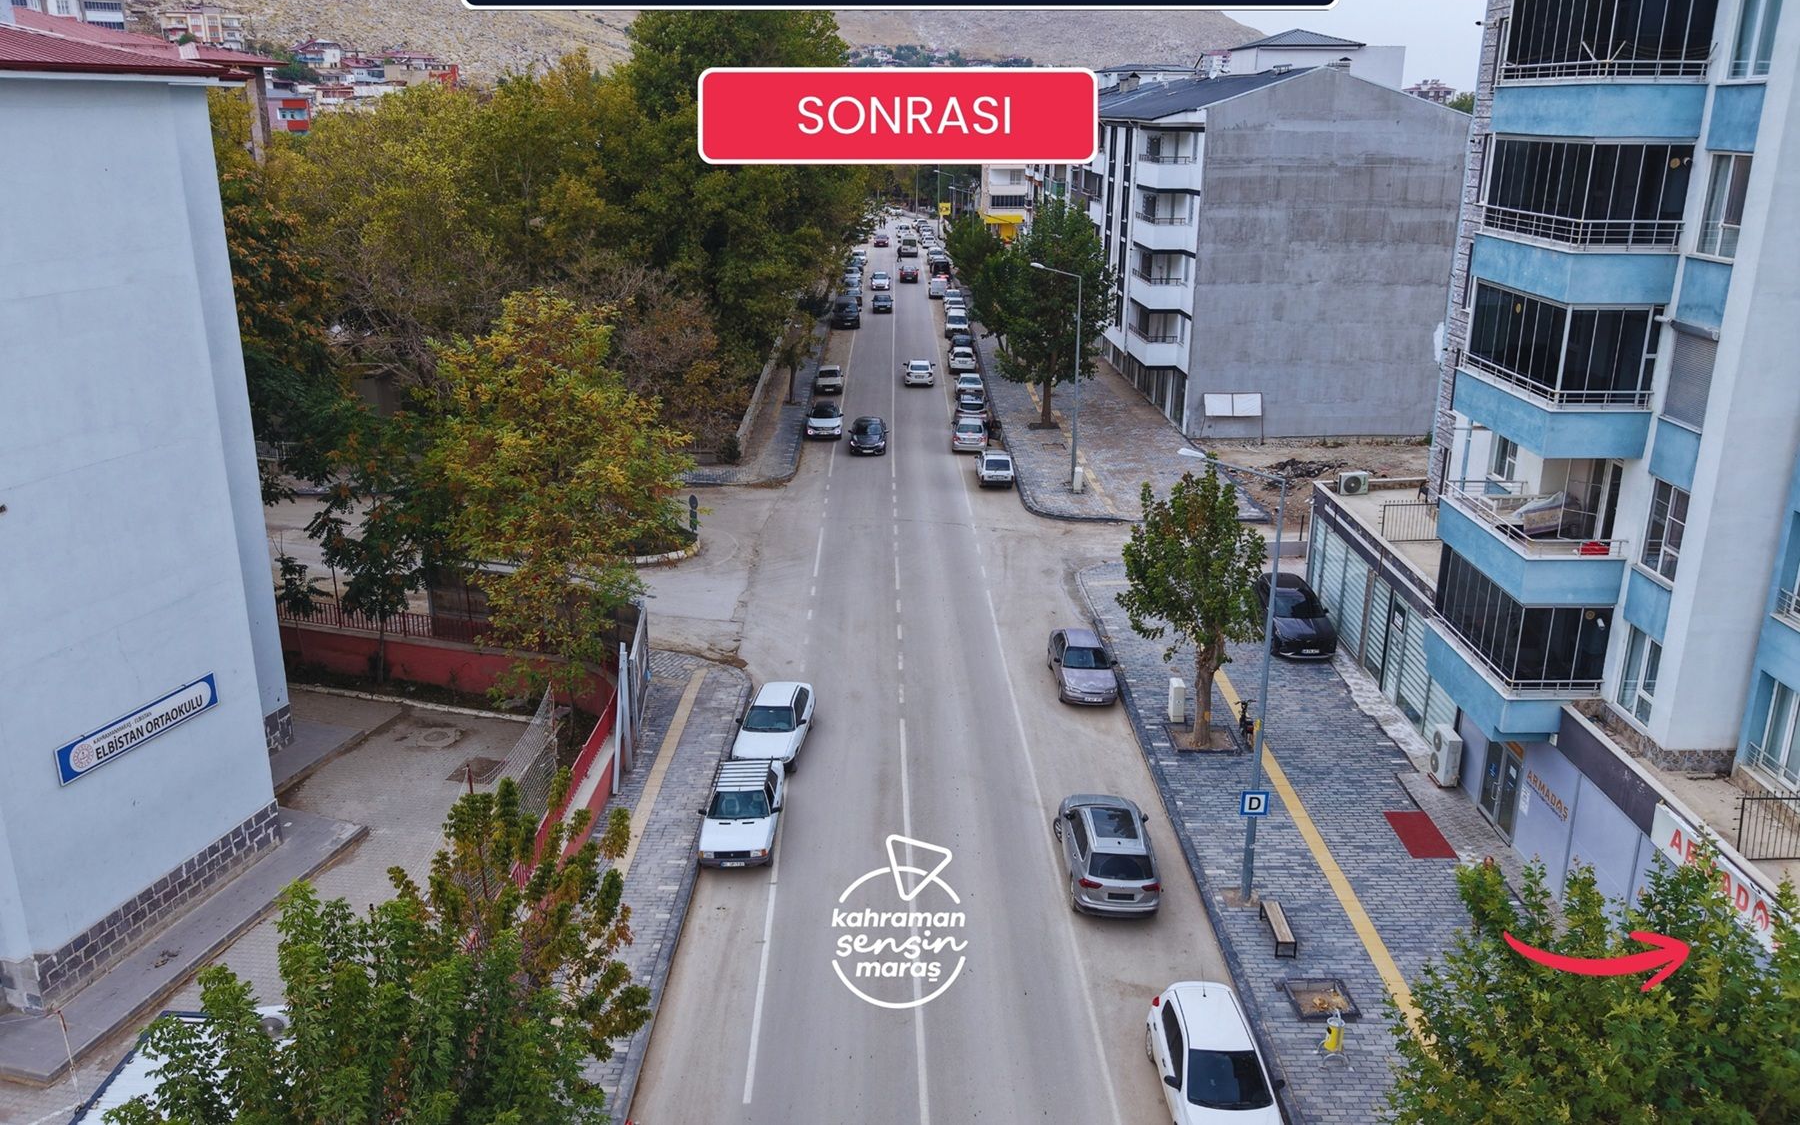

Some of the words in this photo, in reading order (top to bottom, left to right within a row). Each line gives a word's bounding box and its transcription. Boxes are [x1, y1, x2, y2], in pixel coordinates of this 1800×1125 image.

[95, 725, 144, 761] ELBİSTAN
[145, 694, 203, 735] ORTAOKULU
[1248, 796, 1261, 811] D
